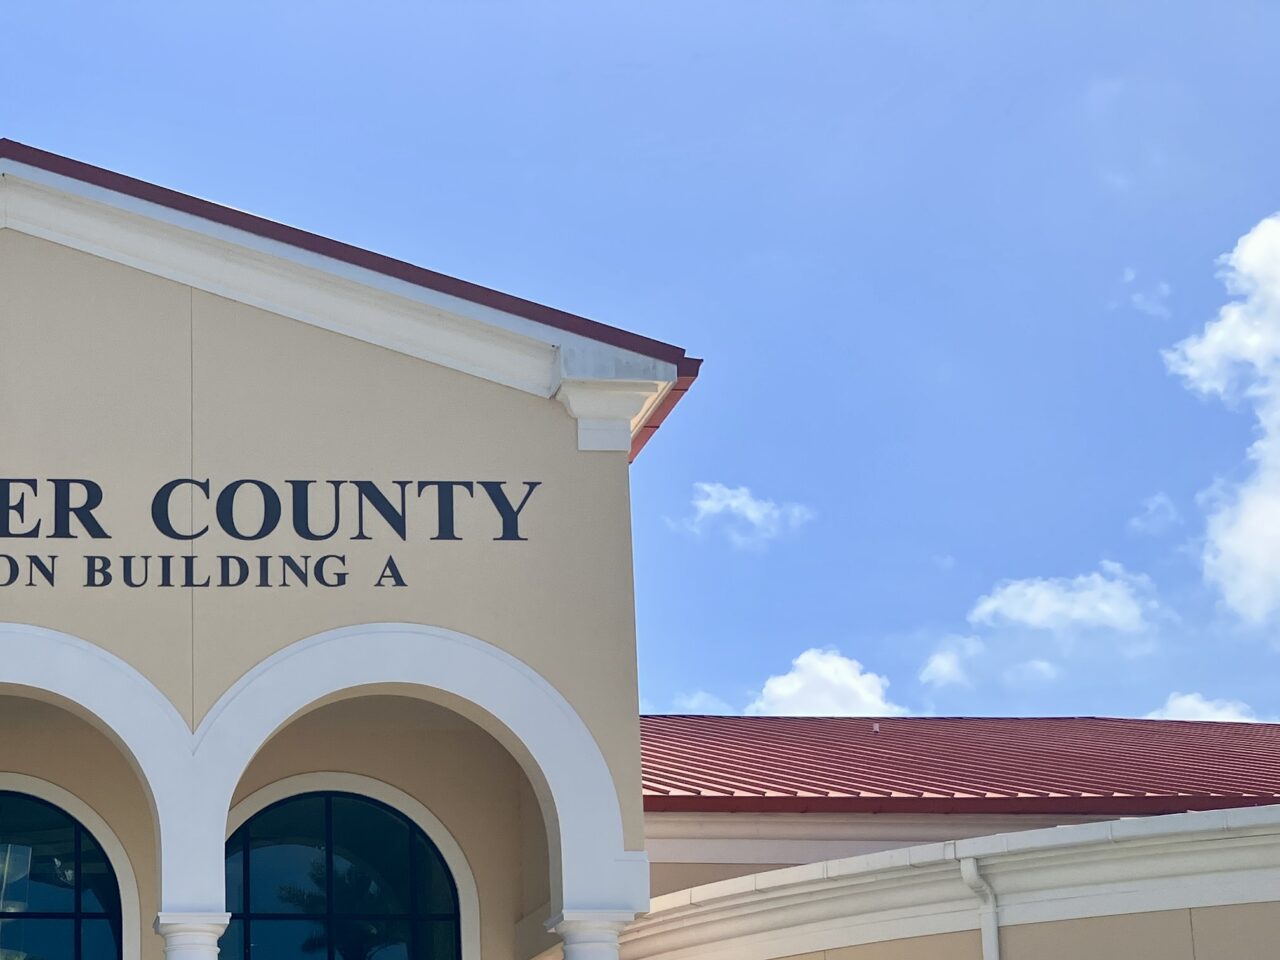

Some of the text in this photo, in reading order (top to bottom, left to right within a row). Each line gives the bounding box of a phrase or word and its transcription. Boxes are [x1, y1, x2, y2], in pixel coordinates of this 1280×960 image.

[151, 477, 542, 541] COUNTY
[83, 554, 350, 588] BUILDING
[373, 554, 408, 588] A
